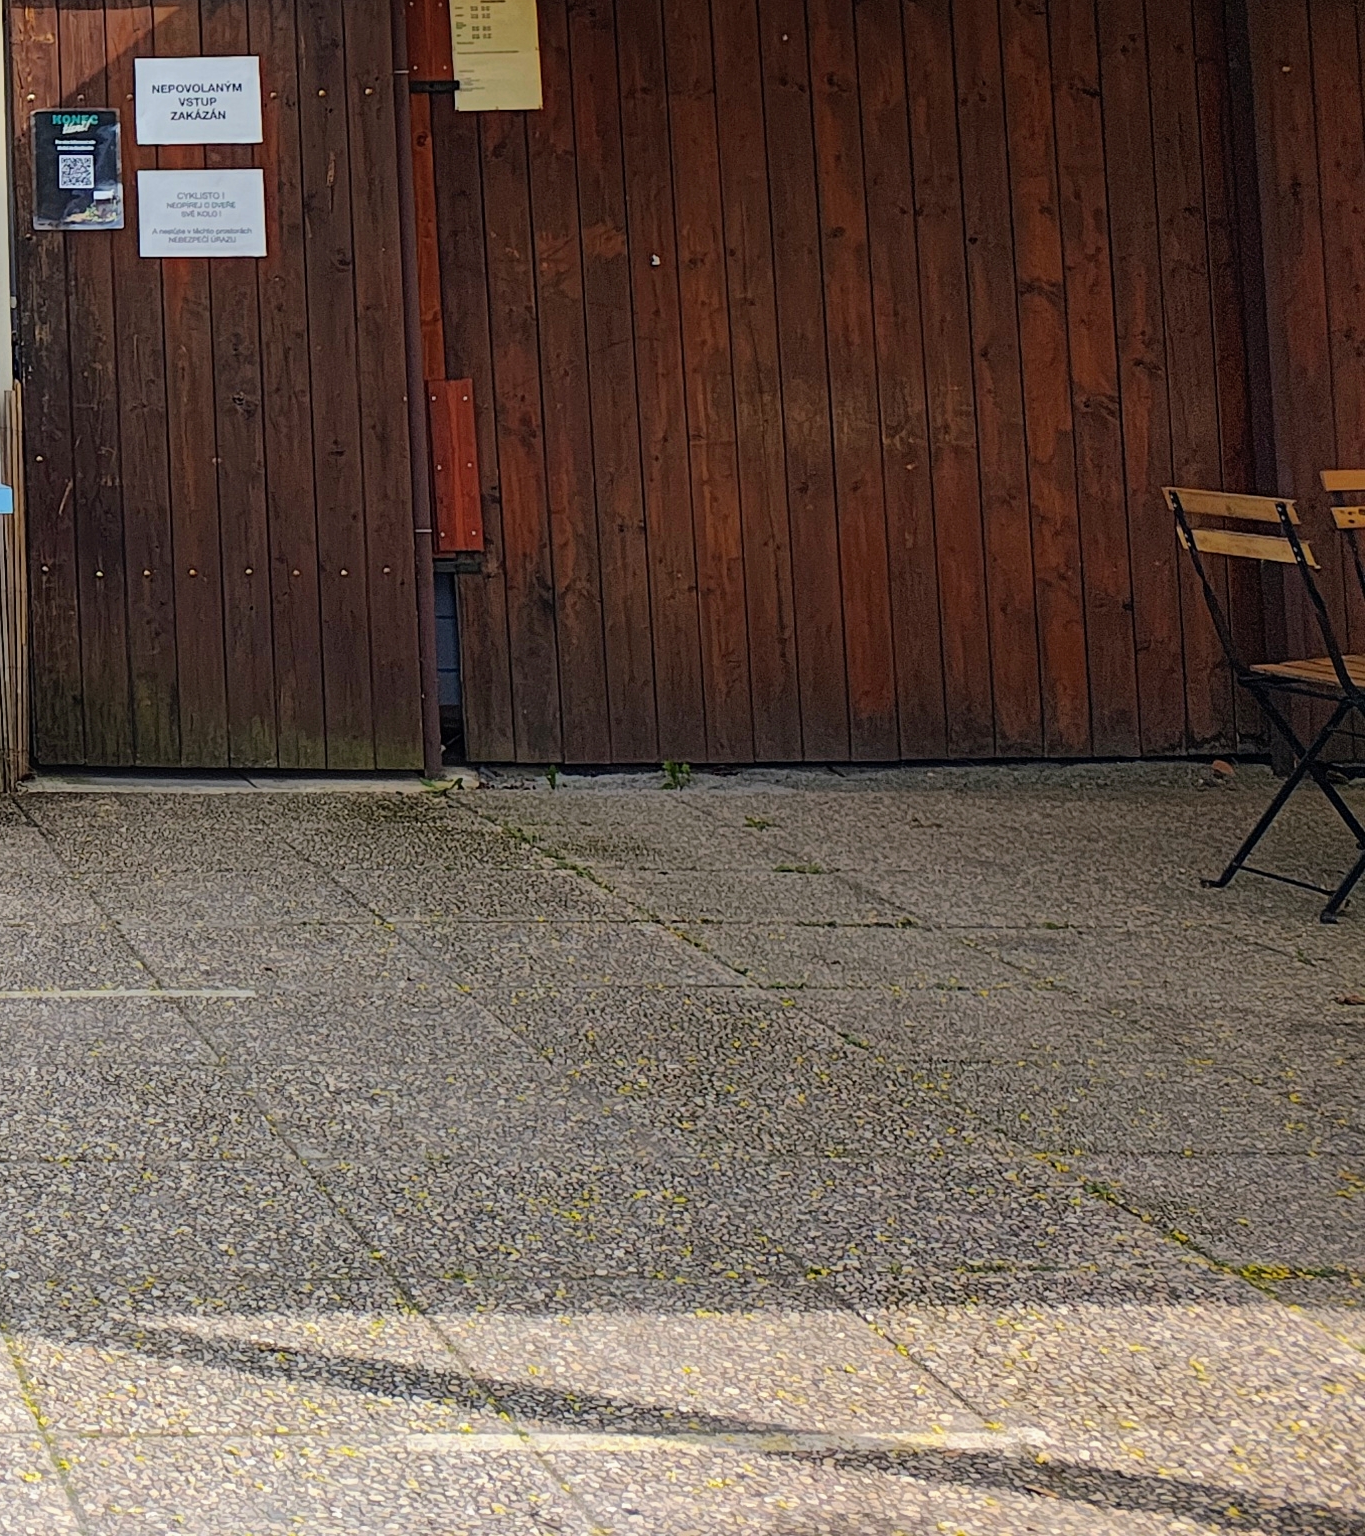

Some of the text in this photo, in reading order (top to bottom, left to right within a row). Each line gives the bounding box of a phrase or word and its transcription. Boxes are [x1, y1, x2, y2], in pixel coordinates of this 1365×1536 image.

[152, 81, 242, 94] NEPOVOLANÝM
[179, 97, 217, 106] VSTUP
[171, 108, 226, 120] ZAKÁZÁN
